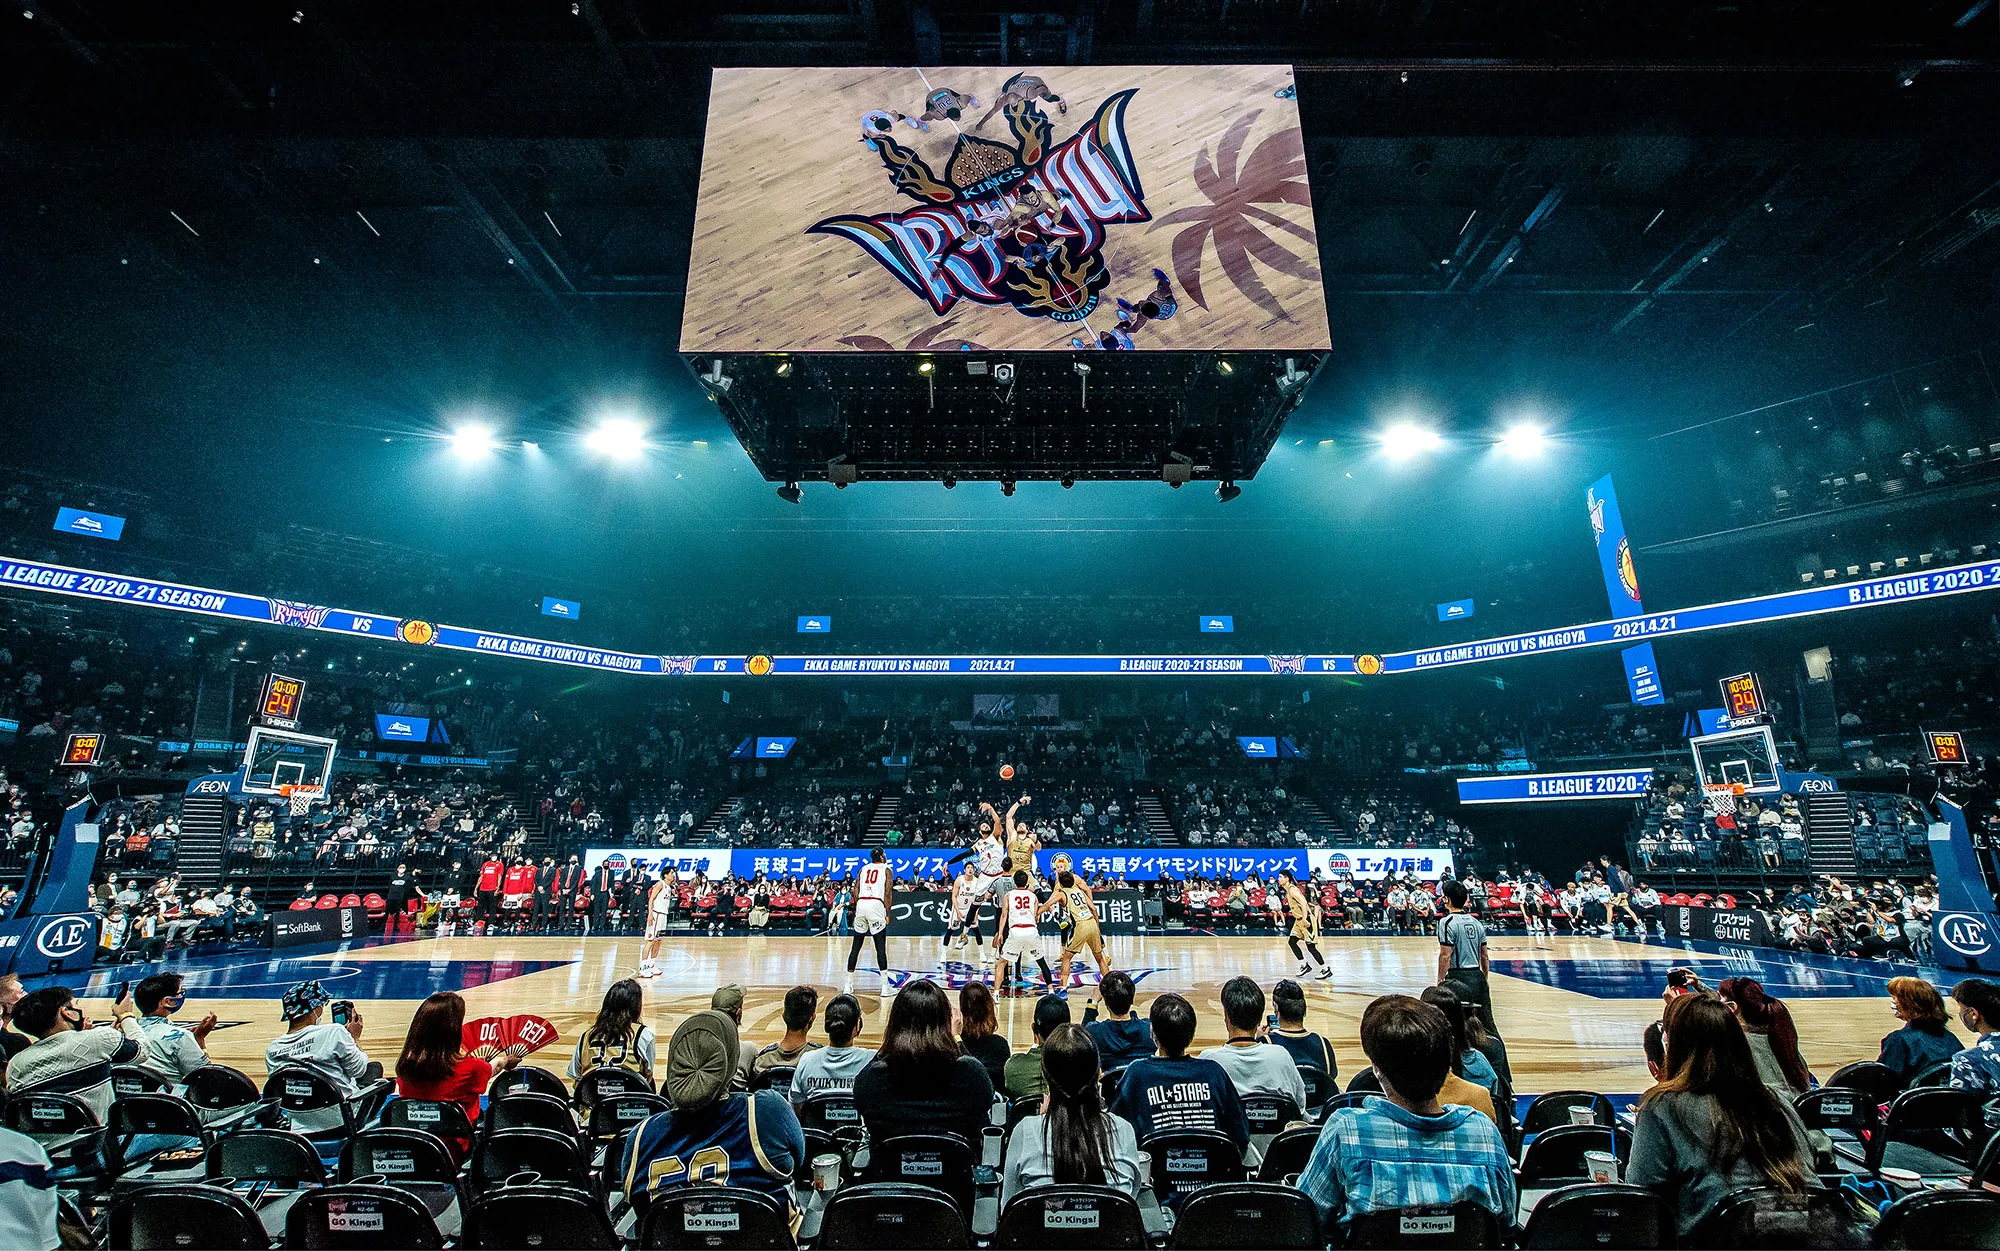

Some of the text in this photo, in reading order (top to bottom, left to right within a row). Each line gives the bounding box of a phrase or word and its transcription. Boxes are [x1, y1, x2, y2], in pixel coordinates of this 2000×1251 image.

[962, 166, 1025, 200] KINGS
[1051, 295, 1098, 321] GOLDEN
[77, 576, 159, 600] 2020-21
[157, 588, 227, 611] SEASON
[1849, 578, 1930, 603] B.LEAGUE
[351, 617, 373, 632] VS
[1612, 615, 1677, 639] 2021.4.21
[476, 635, 642, 670] EKKA GAME RYUKYU VS NAGOYA
[1415, 629, 1587, 666] EKKA GAME RYUKYU VS NAGOYA
[713, 660, 727, 671] VS
[803, 659, 1015, 671] EKKA GAME RYUKYU VS NAGOYA 2021.4.21
[1119, 659, 1243, 671] B.LEAGUE 2020-21 SEASON
[1321, 659, 1336, 671] VS
[273, 680, 298, 696] 10:00
[1729, 678, 1753, 693] 10:00
[267, 692, 292, 715] 24
[1733, 691, 1757, 715] 24
[76, 738, 97, 748] 10:00
[1935, 736, 1956, 746] 10:00
[73, 748, 91, 760] 24
[1939, 746, 1957, 759] 24
[1528, 778, 1593, 795] B.LEAGUE
[1081, 856, 1298, 873] 名古屋ダイヤモンドドルフィンズ
[865, 869, 879, 884] 10
[1014, 896, 1030, 910] 32
[288, 922, 322, 934] SoftBank
[1726, 926, 1751, 940] LIVE
[807, 1077, 847, 1088] RYUKYU
[1147, 1082, 1212, 1106] ALL STARS
[331, 1218, 380, 1227] GO Kings!
[705, 1219, 737, 1228] Kings!
[1065, 1215, 1096, 1225] Kings!
[1421, 1221, 1452, 1231] Kings!
